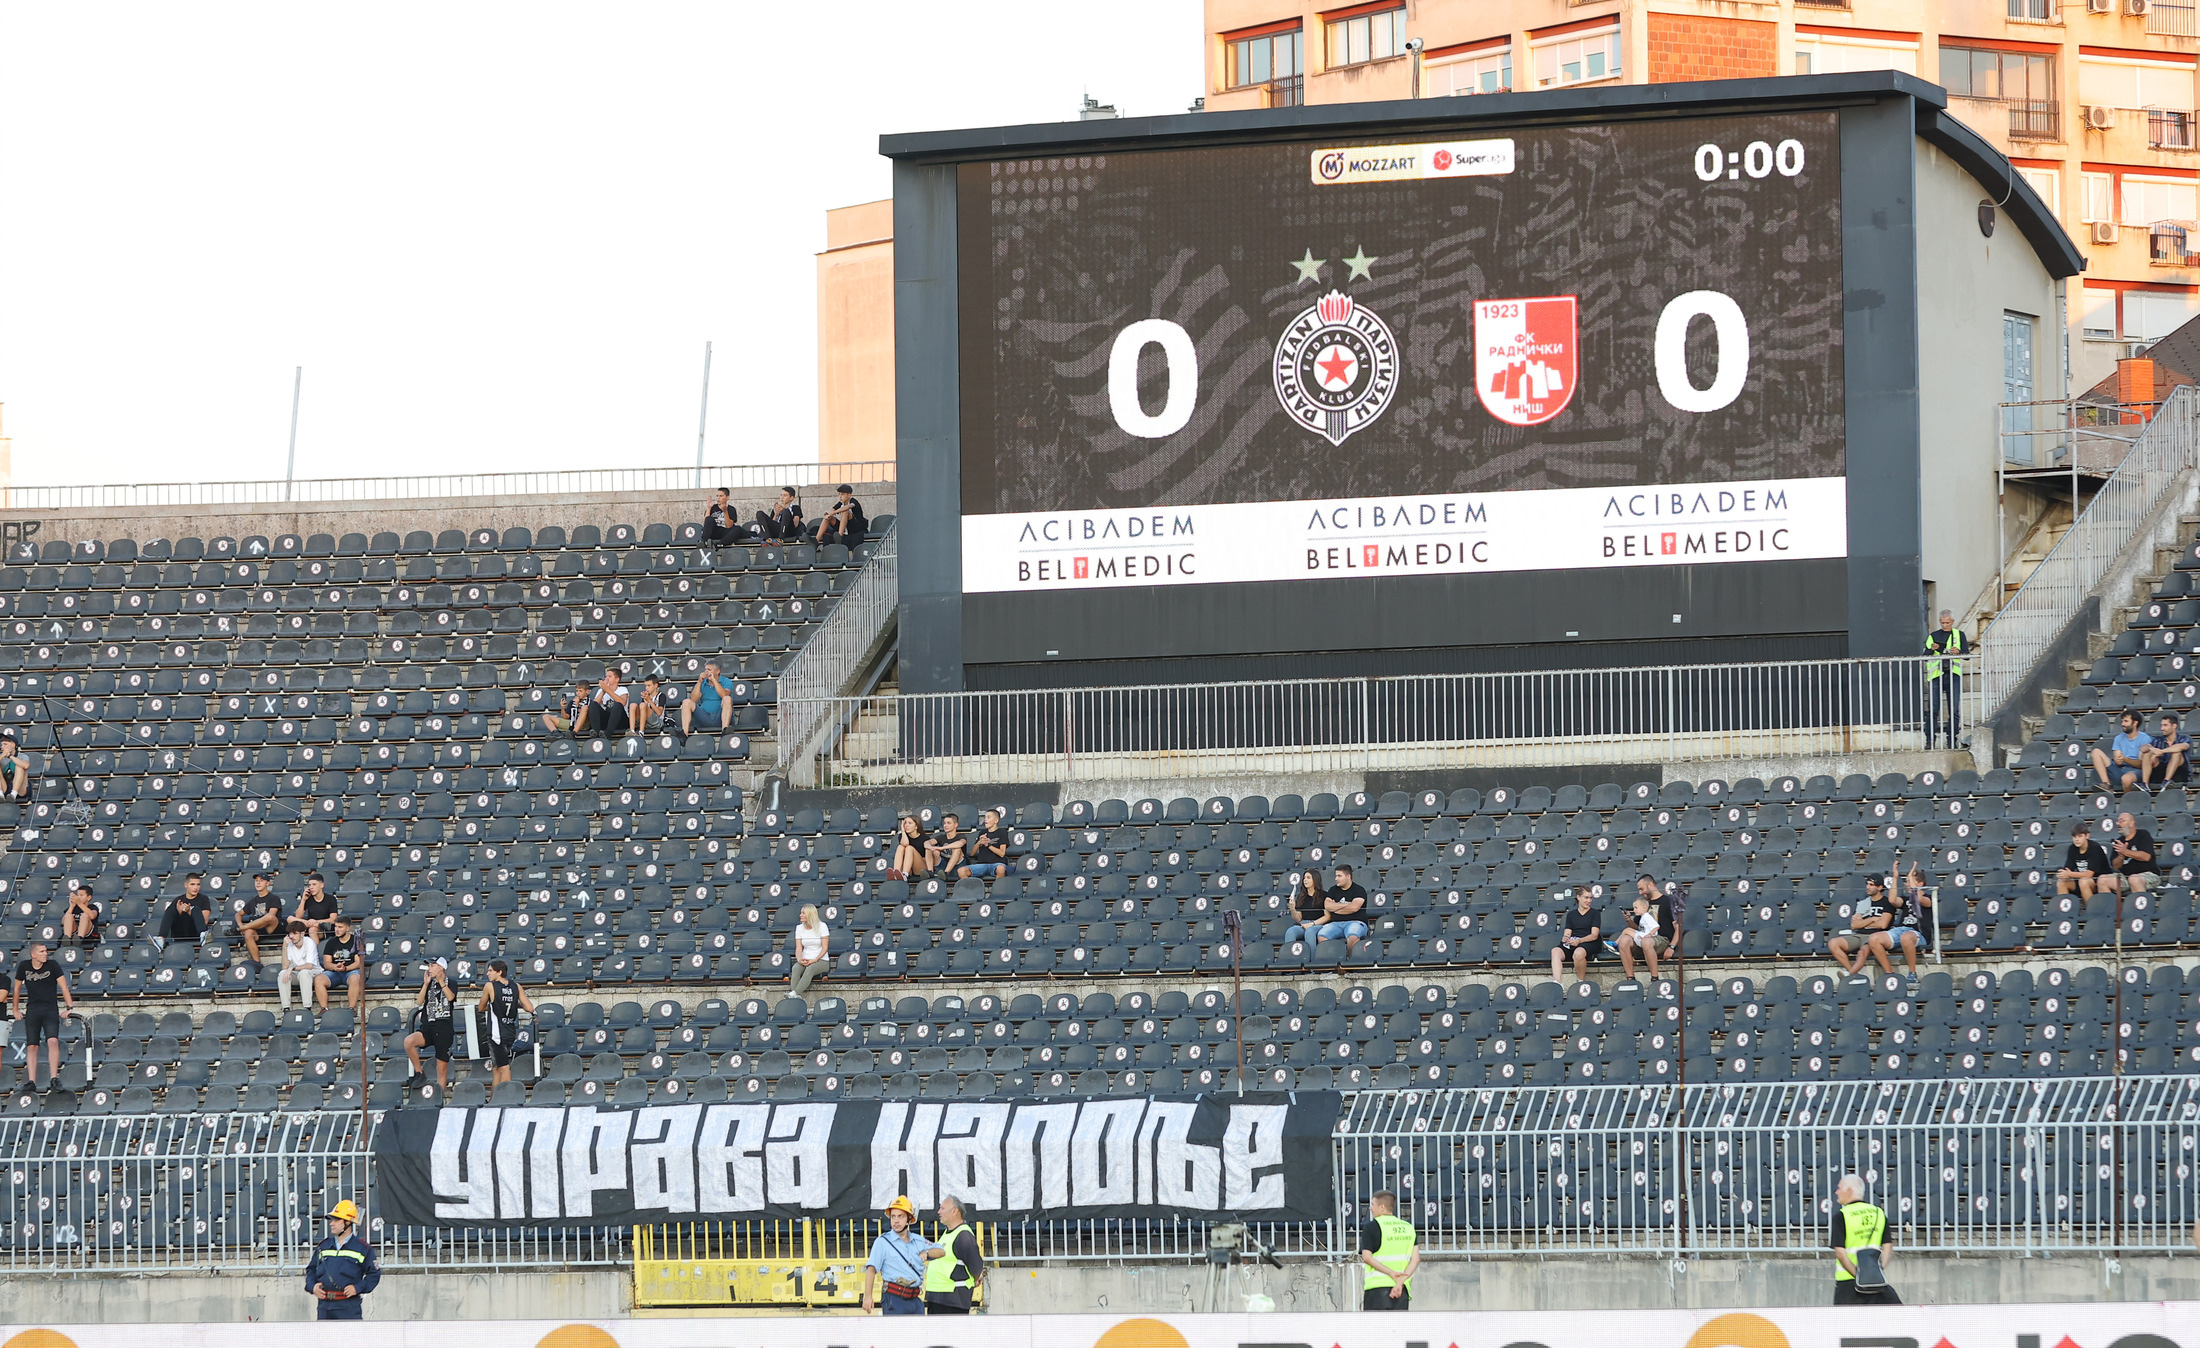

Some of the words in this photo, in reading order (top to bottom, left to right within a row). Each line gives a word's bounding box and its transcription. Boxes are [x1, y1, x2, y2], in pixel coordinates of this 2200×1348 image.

[1349, 157, 1416, 172] MOZZART
[1694, 139, 1805, 181] 0:00
[1481, 304, 1519, 319] 1923
[1489, 343, 1564, 357] РАДНИЧКИ
[1514, 332, 1536, 343] ФК
[1655, 290, 1750, 413] 0
[1302, 333, 1370, 371] FUDBALSKI
[1108, 319, 1198, 439] 0
[1280, 318, 1318, 423] PARTIZAN
[1318, 390, 1354, 404] KLUB
[1513, 403, 1544, 414] НИШ
[1307, 502, 1487, 530] ACIBADEM
[1603, 489, 1788, 517] ACIBADEM
[1019, 514, 1195, 542] ACIBADEM
[787, 1266, 838, 1297] 14
